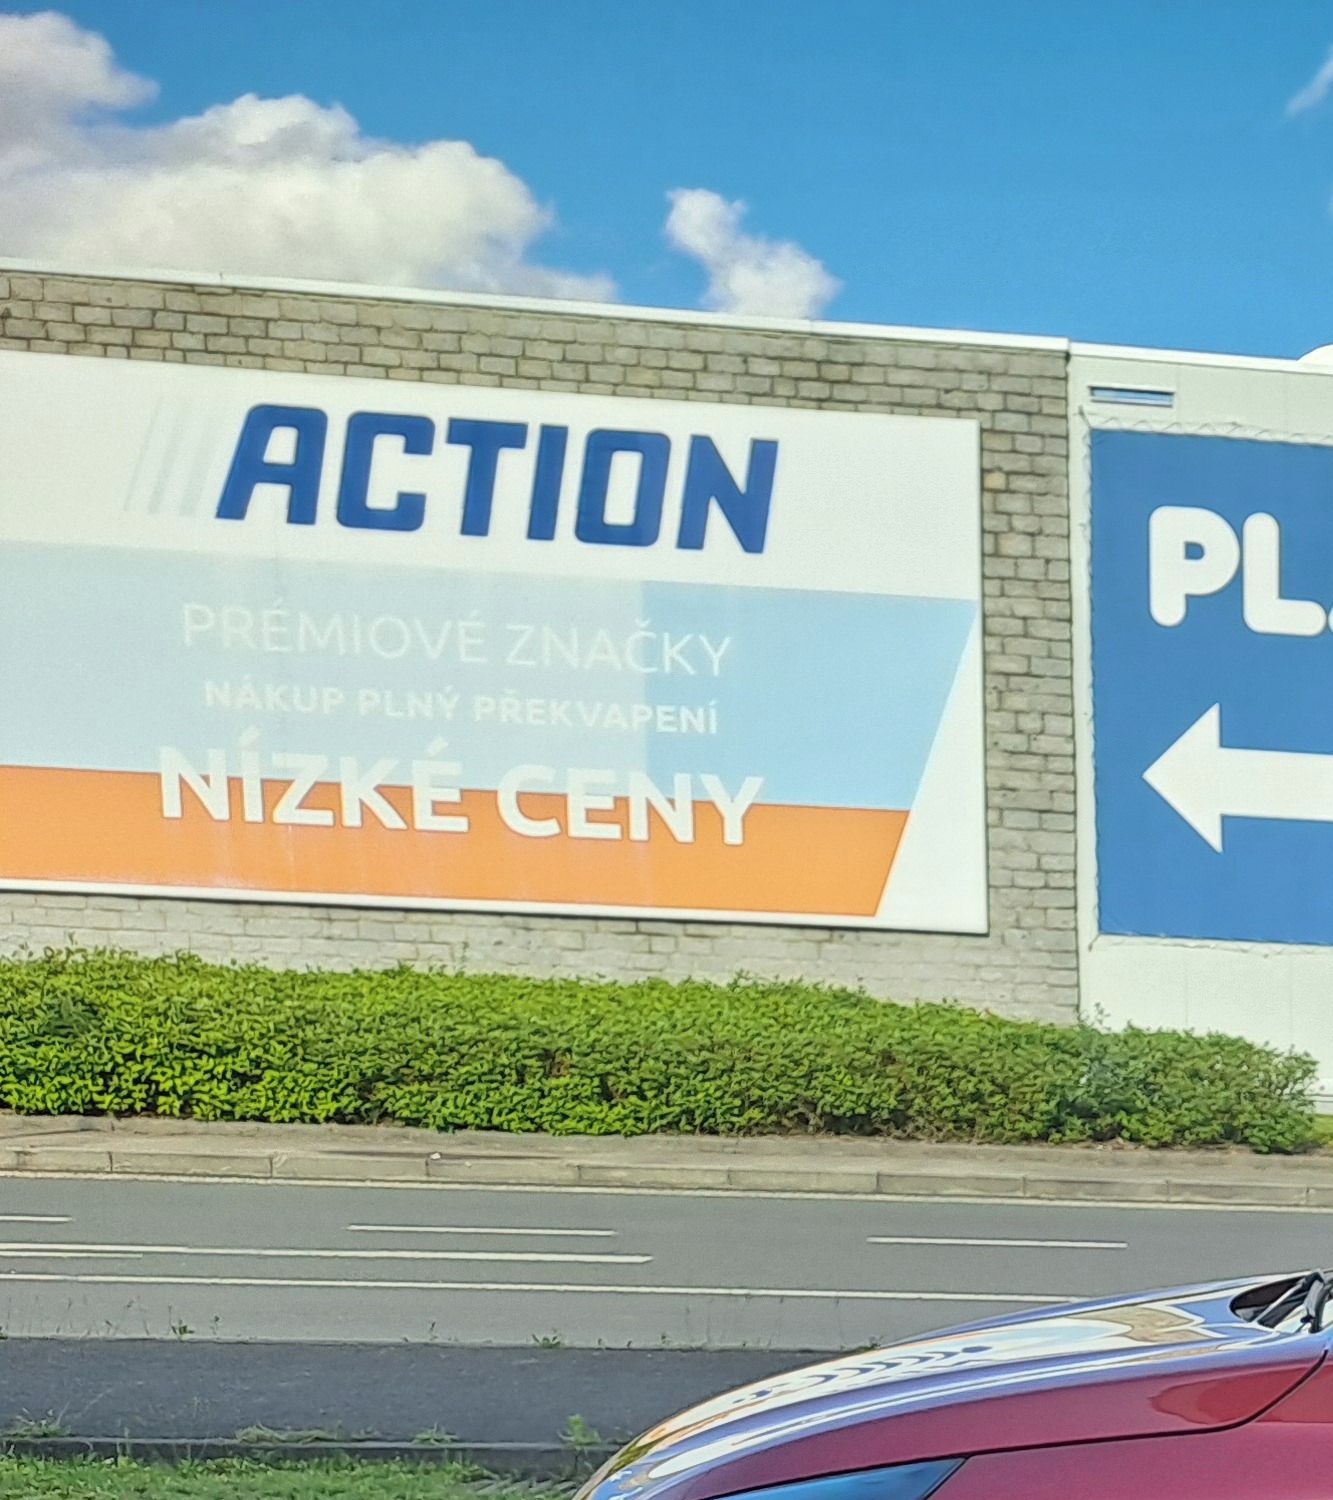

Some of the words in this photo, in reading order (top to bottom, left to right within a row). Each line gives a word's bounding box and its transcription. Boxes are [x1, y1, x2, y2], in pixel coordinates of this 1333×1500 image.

[216, 403, 779, 553] ACTION
[182, 602, 485, 666] PRÉMIOVÉ
[506, 616, 734, 677] ZNAČKY
[204, 677, 345, 716] NÁKUP
[358, 678, 458, 723] PLNÝ
[474, 686, 718, 736] PŘEKVAPENÍ
[157, 725, 470, 835] NÍZKÉ
[497, 762, 764, 846] CENY
